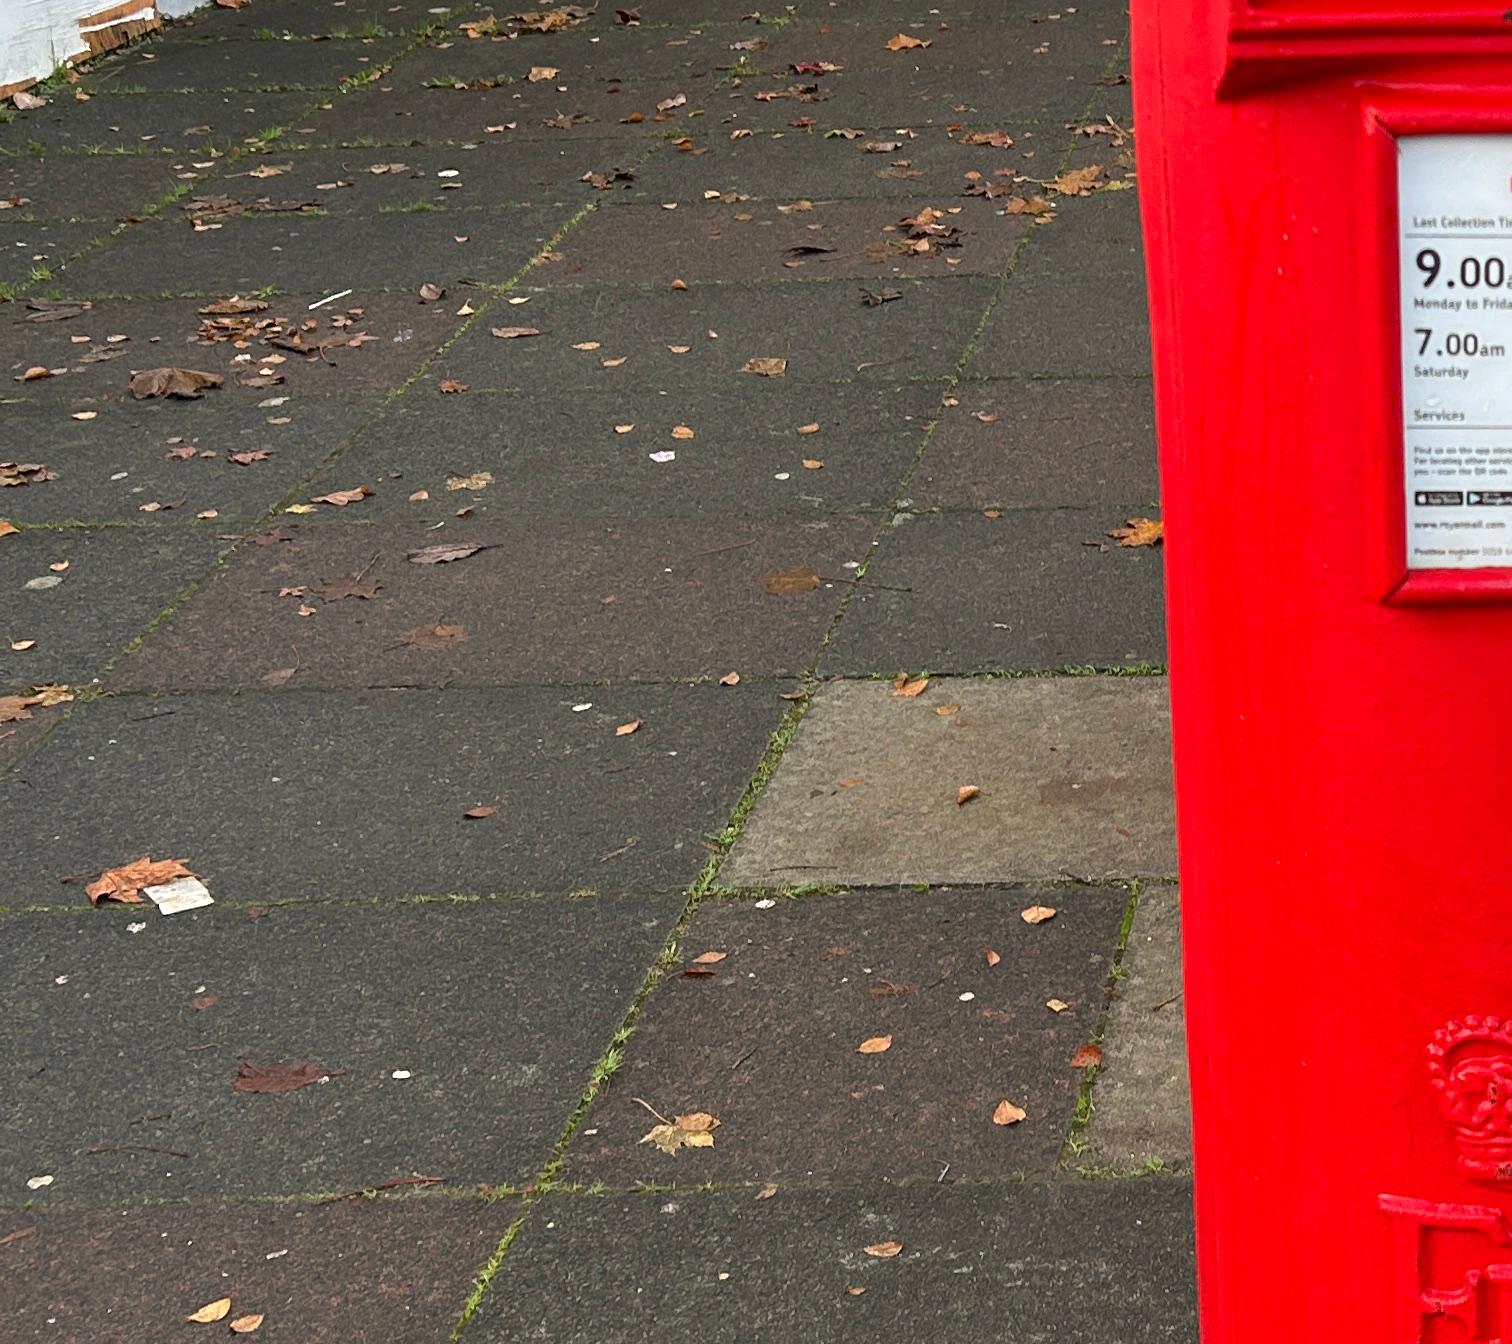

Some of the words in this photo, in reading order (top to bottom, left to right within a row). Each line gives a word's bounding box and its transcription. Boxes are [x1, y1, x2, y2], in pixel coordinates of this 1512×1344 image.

[1412, 216, 1438, 229] Last
[1441, 216, 1495, 229] Collection
[1414, 298, 1462, 312] Monday
[1466, 298, 1479, 310] to
[1414, 327, 1506, 358] 7.00am
[1414, 365, 1470, 379] Saturday
[1413, 408, 1466, 422] Services
[1458, 446, 1473, 455] the
